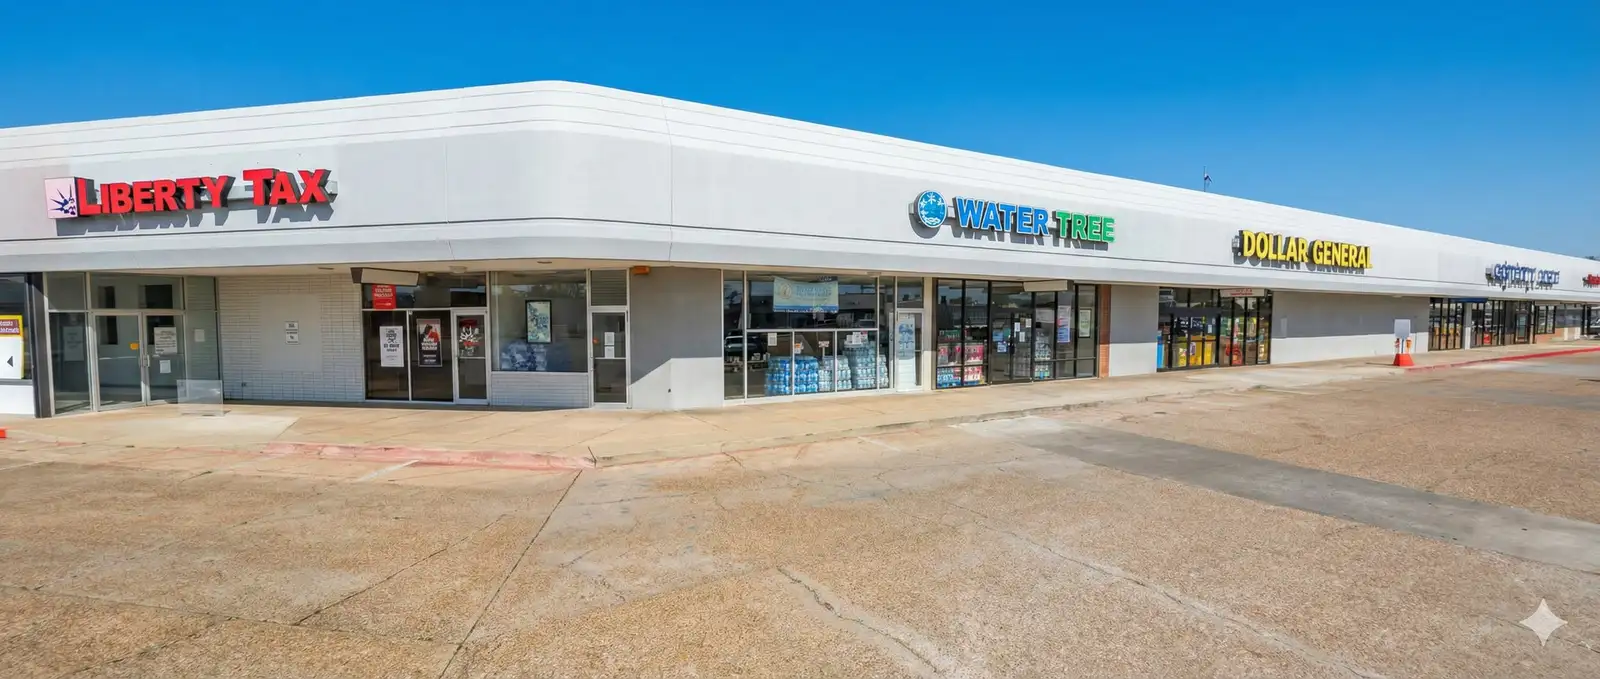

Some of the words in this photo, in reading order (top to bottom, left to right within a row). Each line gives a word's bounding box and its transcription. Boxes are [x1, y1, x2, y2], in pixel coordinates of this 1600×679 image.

[77, 175, 230, 215] LIBERTY
[243, 169, 328, 206] TAX
[955, 196, 1049, 235] WATER
[1056, 210, 1116, 243] TREE
[1242, 230, 1309, 262] DOLLAR
[1312, 239, 1373, 269] GENERAL
